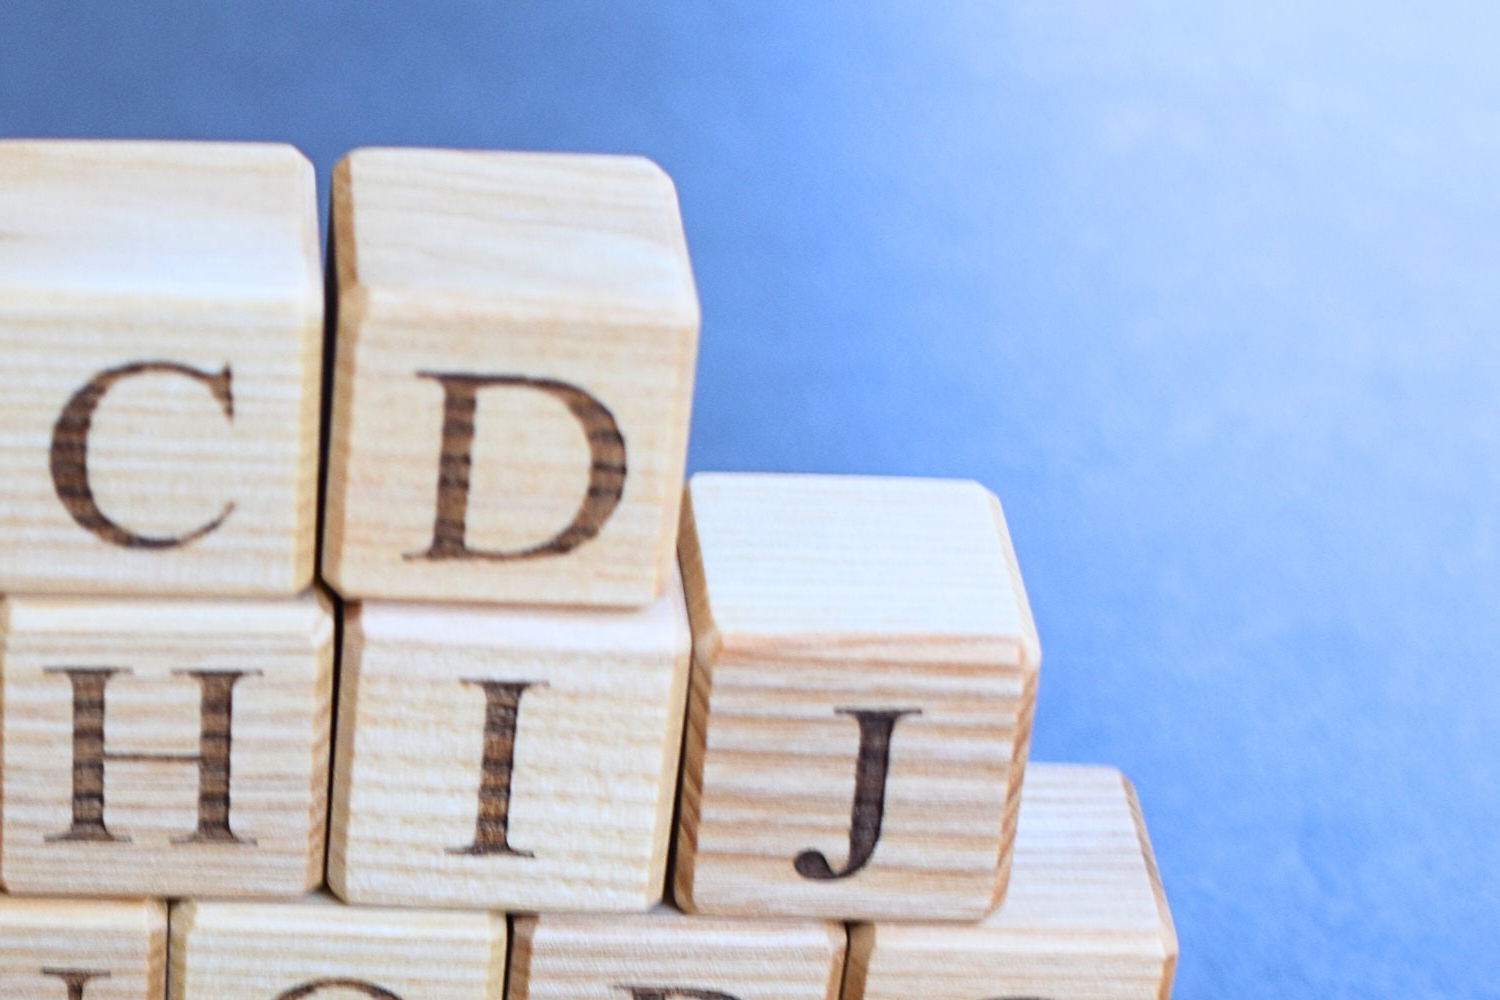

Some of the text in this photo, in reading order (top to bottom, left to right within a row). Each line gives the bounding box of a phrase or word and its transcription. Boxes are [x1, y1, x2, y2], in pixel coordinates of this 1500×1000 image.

[49, 361, 235, 551] C
[401, 371, 628, 562] D
[42, 667, 264, 846] H
[446, 679, 547, 858] I
[793, 709, 921, 881] J
